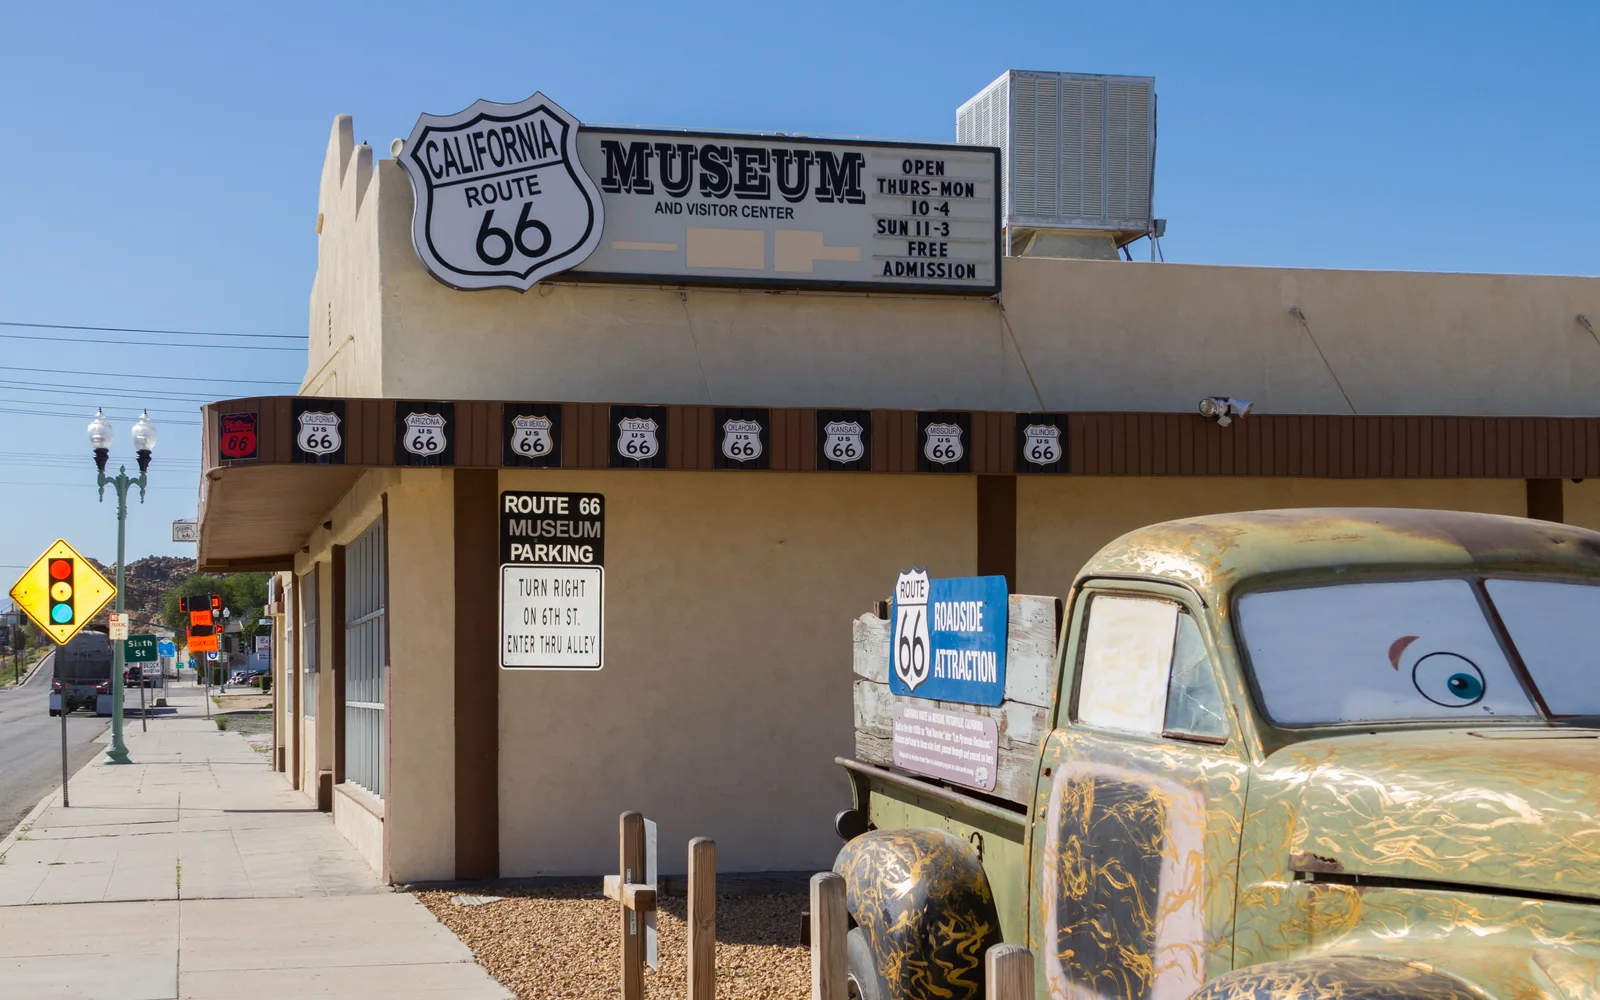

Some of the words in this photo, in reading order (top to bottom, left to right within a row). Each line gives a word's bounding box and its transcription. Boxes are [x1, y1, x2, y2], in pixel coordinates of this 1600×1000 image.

[426, 119, 558, 179] CALIFORNIA
[601, 140, 865, 204] MUSEUM
[902, 159, 944, 176] OPEN
[465, 174, 541, 208] ROUTE
[877, 178, 974, 197] THURS-MON
[655, 201, 683, 214] AND
[686, 203, 738, 217] VISITOR
[742, 205, 794, 219] CENTER
[476, 202, 551, 265] 66
[877, 219, 908, 235] SUN
[909, 241, 948, 257] FREE
[883, 261, 975, 279] ADMISSION
[305, 414, 335, 424] CALIFORNIA
[410, 418, 440, 426] ARIZONA
[517, 420, 528, 428] NEW
[529, 420, 547, 428] MEXICO
[627, 422, 650, 430] TEXAS
[728, 424, 757, 432] OKLAHOMA
[831, 426, 857, 434] KANSAS
[930, 427, 958, 435] MISSOURI
[228, 435, 249, 451] 66
[307, 434, 332, 449] 66
[412, 435, 438, 450] 66
[520, 438, 545, 453] 66
[626, 440, 651, 455] 66
[730, 441, 754, 456] 66
[832, 443, 856, 458] 66
[932, 445, 956, 459] 66
[1031, 445, 1054, 459] 66
[505, 495, 569, 515] ROUTE
[579, 497, 600, 515] 66
[509, 519, 600, 538] MUSEUM
[510, 543, 593, 563] PARKING
[519, 579, 548, 597] TURN
[553, 579, 586, 597] RIGHT
[901, 580, 925, 599] ROUTE
[523, 607, 537, 625] ON
[542, 607, 561, 626] 6TH
[566, 608, 580, 626] ST.
[934, 601, 983, 632] ROADSIDE
[507, 635, 535, 653] ENTER
[540, 635, 562, 654] THRU
[567, 636, 596, 654] ALLEY
[899, 608, 925, 677] 66
[934, 649, 997, 683] ATTRACTION
